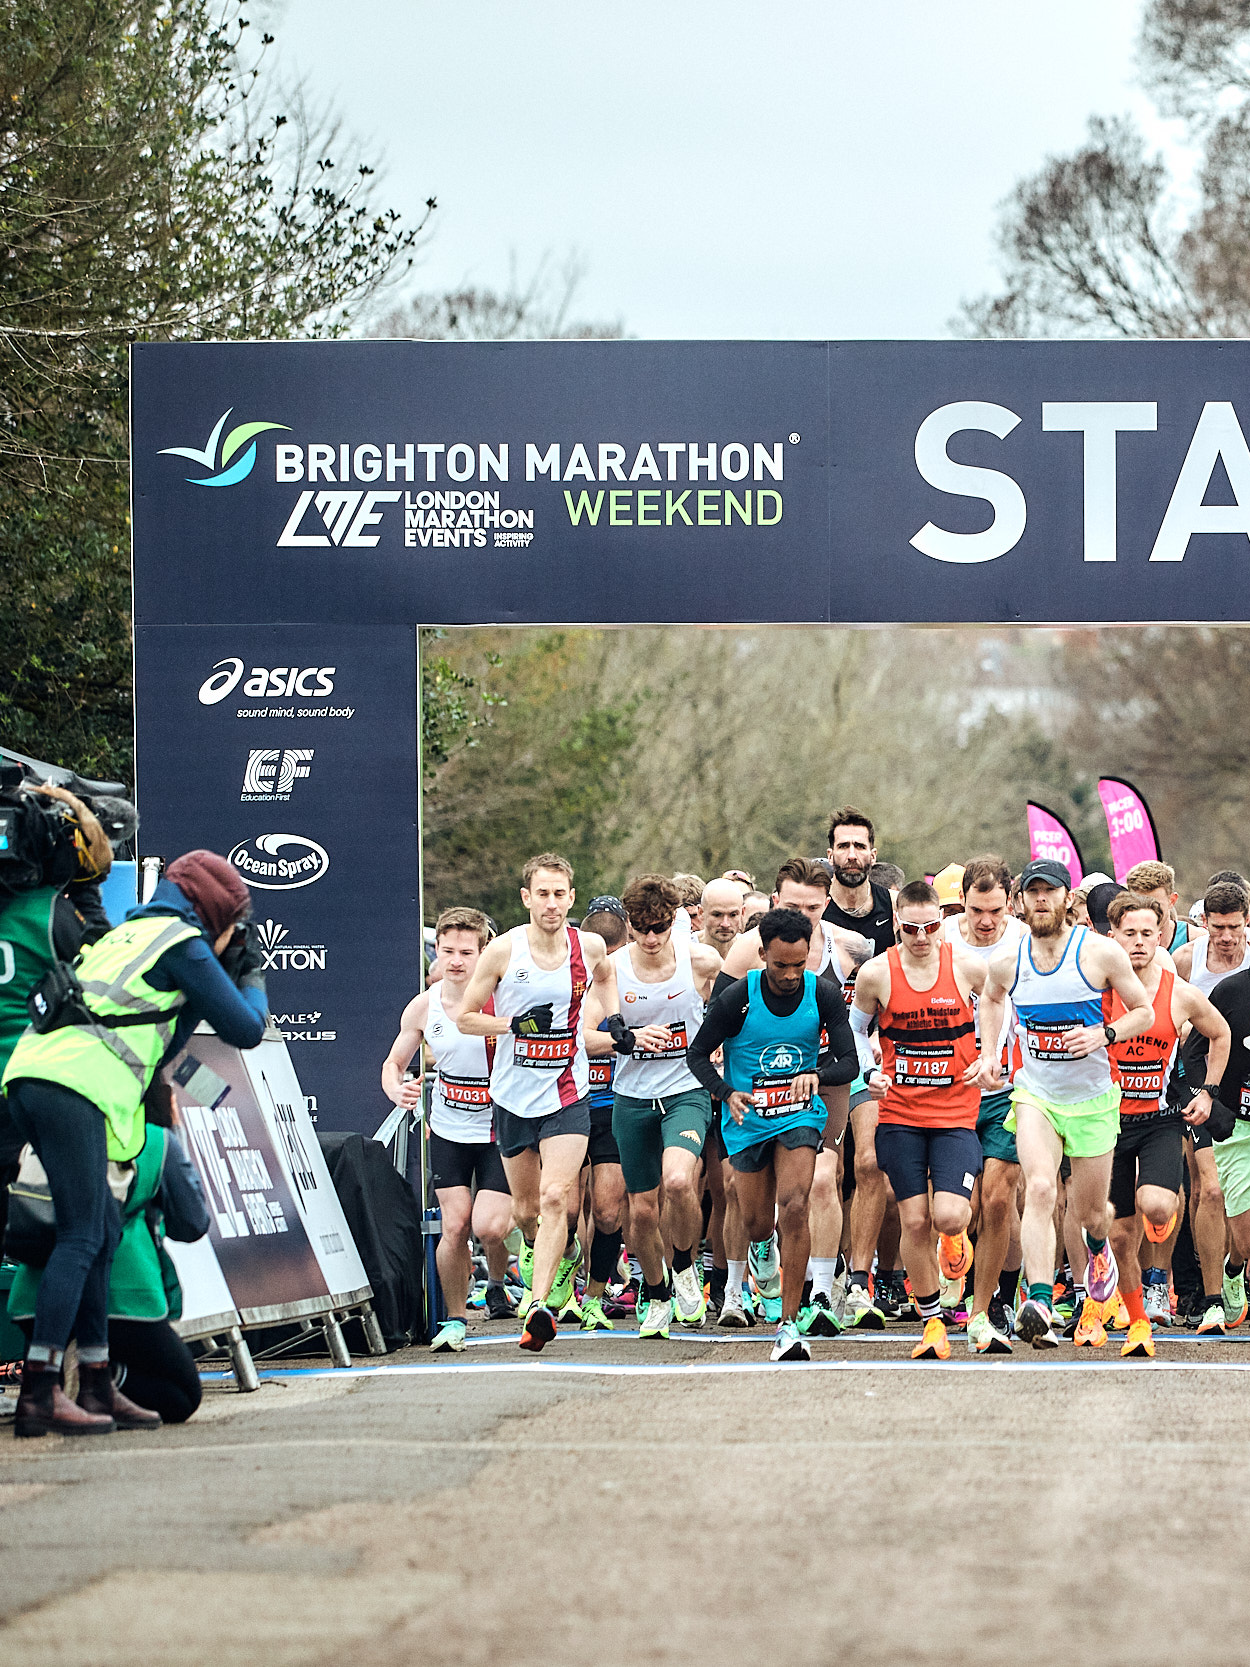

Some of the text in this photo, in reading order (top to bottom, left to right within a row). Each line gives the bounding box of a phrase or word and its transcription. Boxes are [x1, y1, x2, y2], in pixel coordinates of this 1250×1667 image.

[276, 443, 509, 483] BRIGHTON
[404, 491, 500, 510] LONDON
[563, 489, 784, 526] WEEKEND
[404, 510, 534, 528] MARATHON
[404, 528, 487, 547] EVENTS
[494, 533, 534, 541] INSPIRING
[494, 540, 530, 548] ACTIVITY
[237, 706, 355, 720] sound mind, sound body
[242, 749, 314, 793] EF
[241, 793, 290, 801] Education First
[234, 849, 277, 877] Ocean
[261, 949, 326, 970] XTON
[281, 1030, 337, 1042] AXUS
[1031, 1039, 1037, 1047] A
[1044, 1036, 1068, 1050] 73
[530, 1043, 570, 1057] 17113
[1126, 1045, 1144, 1056] AC
[899, 1063, 906, 1072] H
[913, 1061, 949, 1075] 7187
[589, 1069, 605, 1081] 06
[1120, 1074, 1160, 1089] 17070
[449, 1087, 487, 1103] 17031
[769, 1089, 792, 1105] 170
[1244, 1096, 1250, 1104] D
